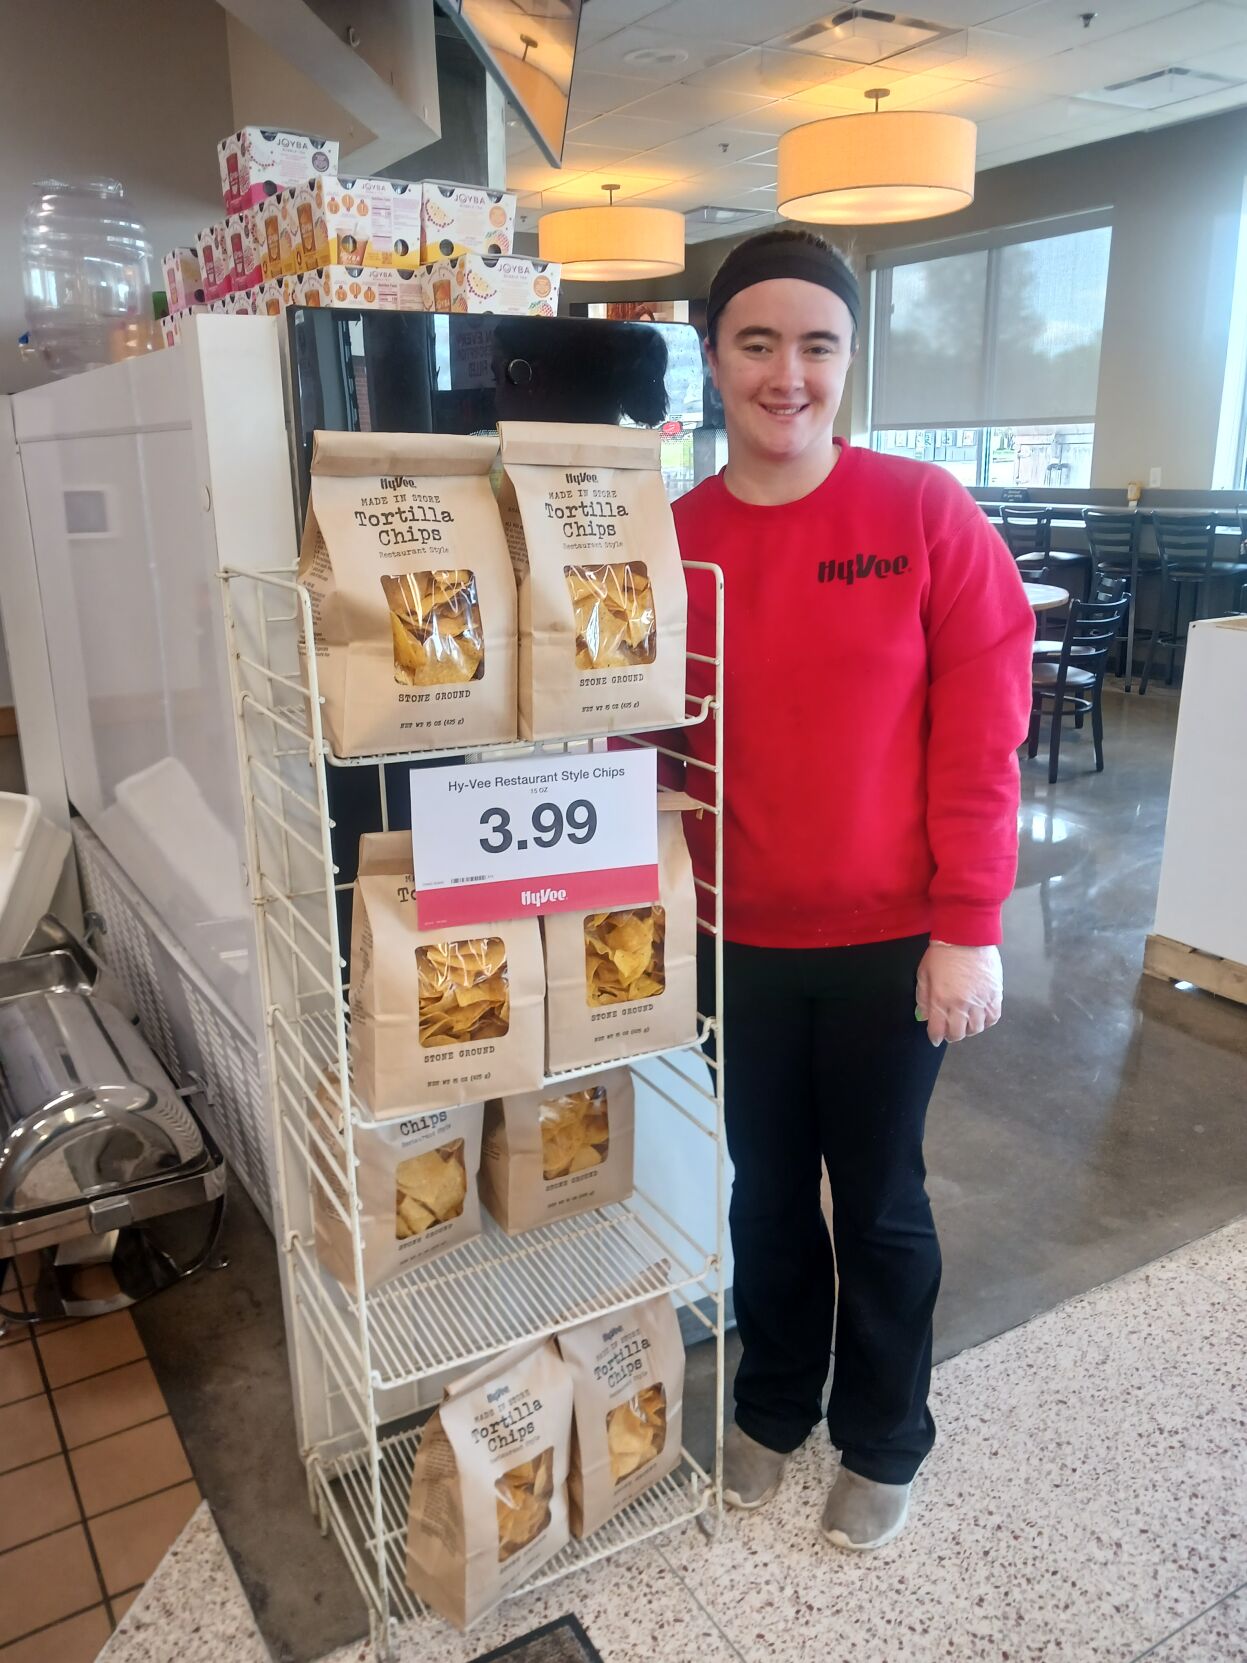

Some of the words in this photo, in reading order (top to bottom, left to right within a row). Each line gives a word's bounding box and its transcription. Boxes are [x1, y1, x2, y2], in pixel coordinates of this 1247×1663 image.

[277, 138, 308, 149] JOYBA
[362, 183, 386, 191] JOYBA
[454, 194, 486, 204] JOYBA
[499, 263, 530, 274] JOYBA
[380, 476, 416, 491] HyVee
[565, 472, 598, 485] HyVee
[361, 497, 388, 506] MADE
[393, 494, 407, 503] IN
[412, 494, 441, 503] STORE
[548, 490, 573, 500] MADE
[578, 490, 588, 498] IN
[592, 490, 618, 498] STORE
[354, 506, 454, 526] Tortilla
[544, 501, 629, 519] Tortilla
[378, 526, 442, 546] Chips
[562, 520, 616, 539] Chips
[379, 548, 427, 559] Restaurant
[429, 546, 449, 554] Style
[562, 541, 602, 550] Restaurant
[604, 541, 623, 549] Style
[818, 553, 910, 586] HyVee
[580, 677, 607, 686] STONE
[612, 674, 644, 684] GROUND
[398, 694, 430, 702] STONE
[435, 690, 471, 700] GROUND
[448, 778, 491, 793] Hy-Vee
[495, 772, 558, 787] Restaurant
[561, 769, 590, 782] Style
[592, 767, 625, 780] Chips
[479, 799, 598, 854] 3.99
[521, 888, 567, 908] HyVee
[591, 1010, 618, 1022] STONE
[622, 1004, 654, 1016] GROUND
[424, 1052, 454, 1063] STONE
[458, 1046, 495, 1058] GROUND
[400, 1111, 448, 1136] Chips
[593, 1338, 651, 1381] Tortilla
[607, 1358, 642, 1388] Chips
[471, 1399, 543, 1445] Tortilla
[488, 1421, 535, 1452] Chips
